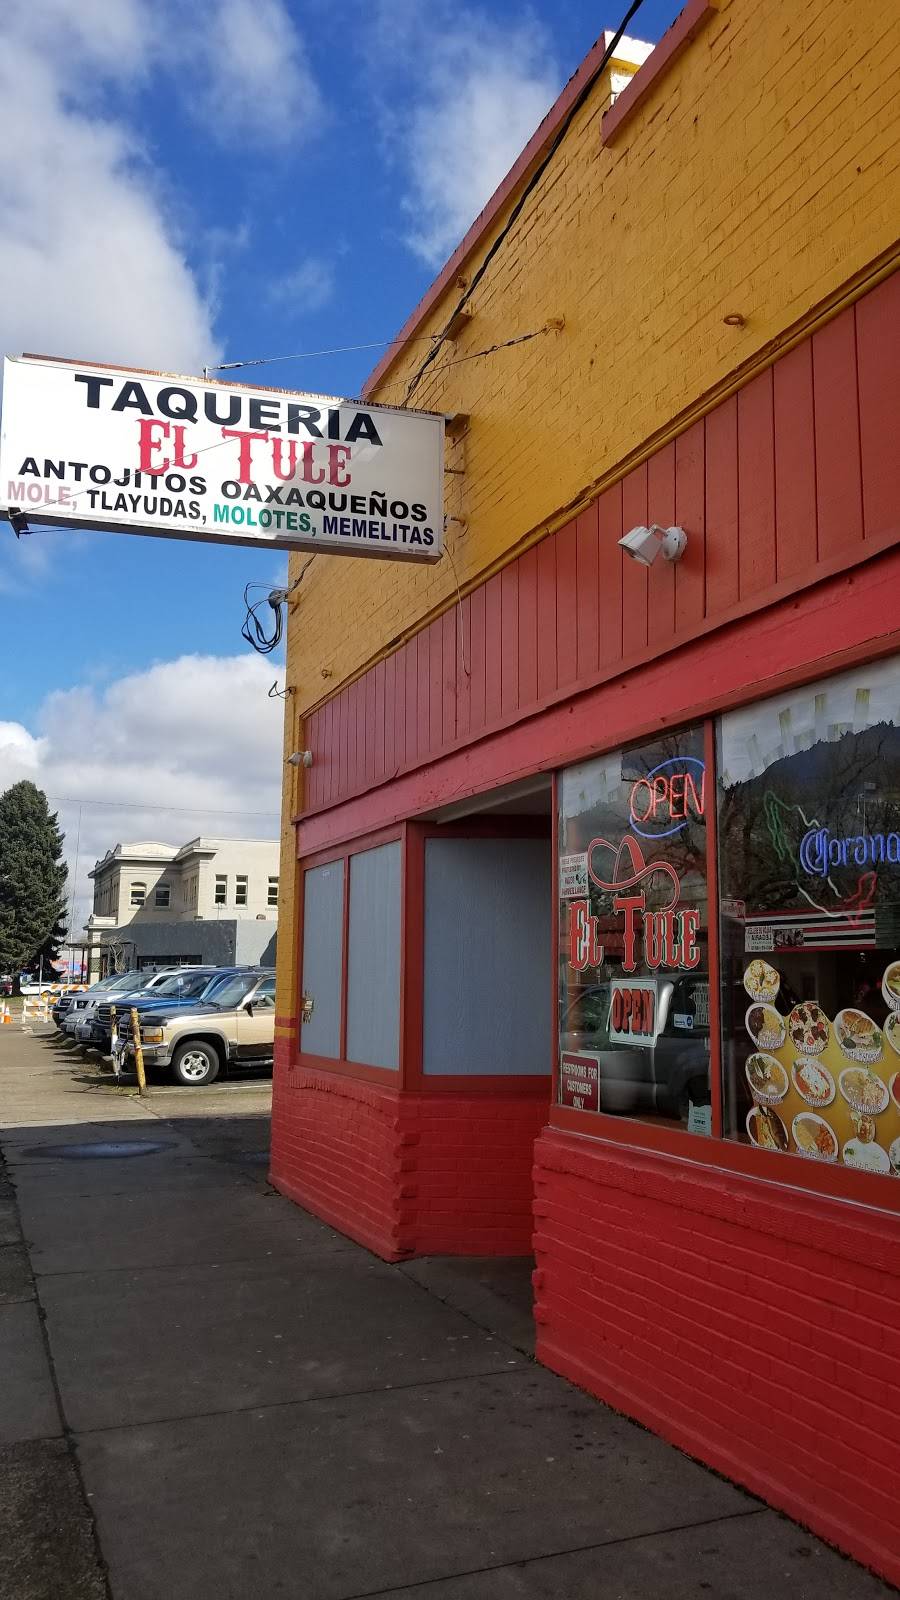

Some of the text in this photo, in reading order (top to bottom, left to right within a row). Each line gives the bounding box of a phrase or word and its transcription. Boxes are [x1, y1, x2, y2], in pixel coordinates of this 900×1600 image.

[75, 374, 383, 446] TAQUERIA
[137, 418, 352, 487] EL TULE
[7, 480, 434, 545] MOLE, TLAYUDAS, MOLOTES, MEMELITAS
[18, 456, 428, 522] ANTOJITOS OAXAQUEÑOS
[630, 772, 705, 821] OPEN
[568, 889, 701, 972] EL TULE
[612, 987, 656, 1037] OPEN
[588, 1066, 598, 1080] FOR
